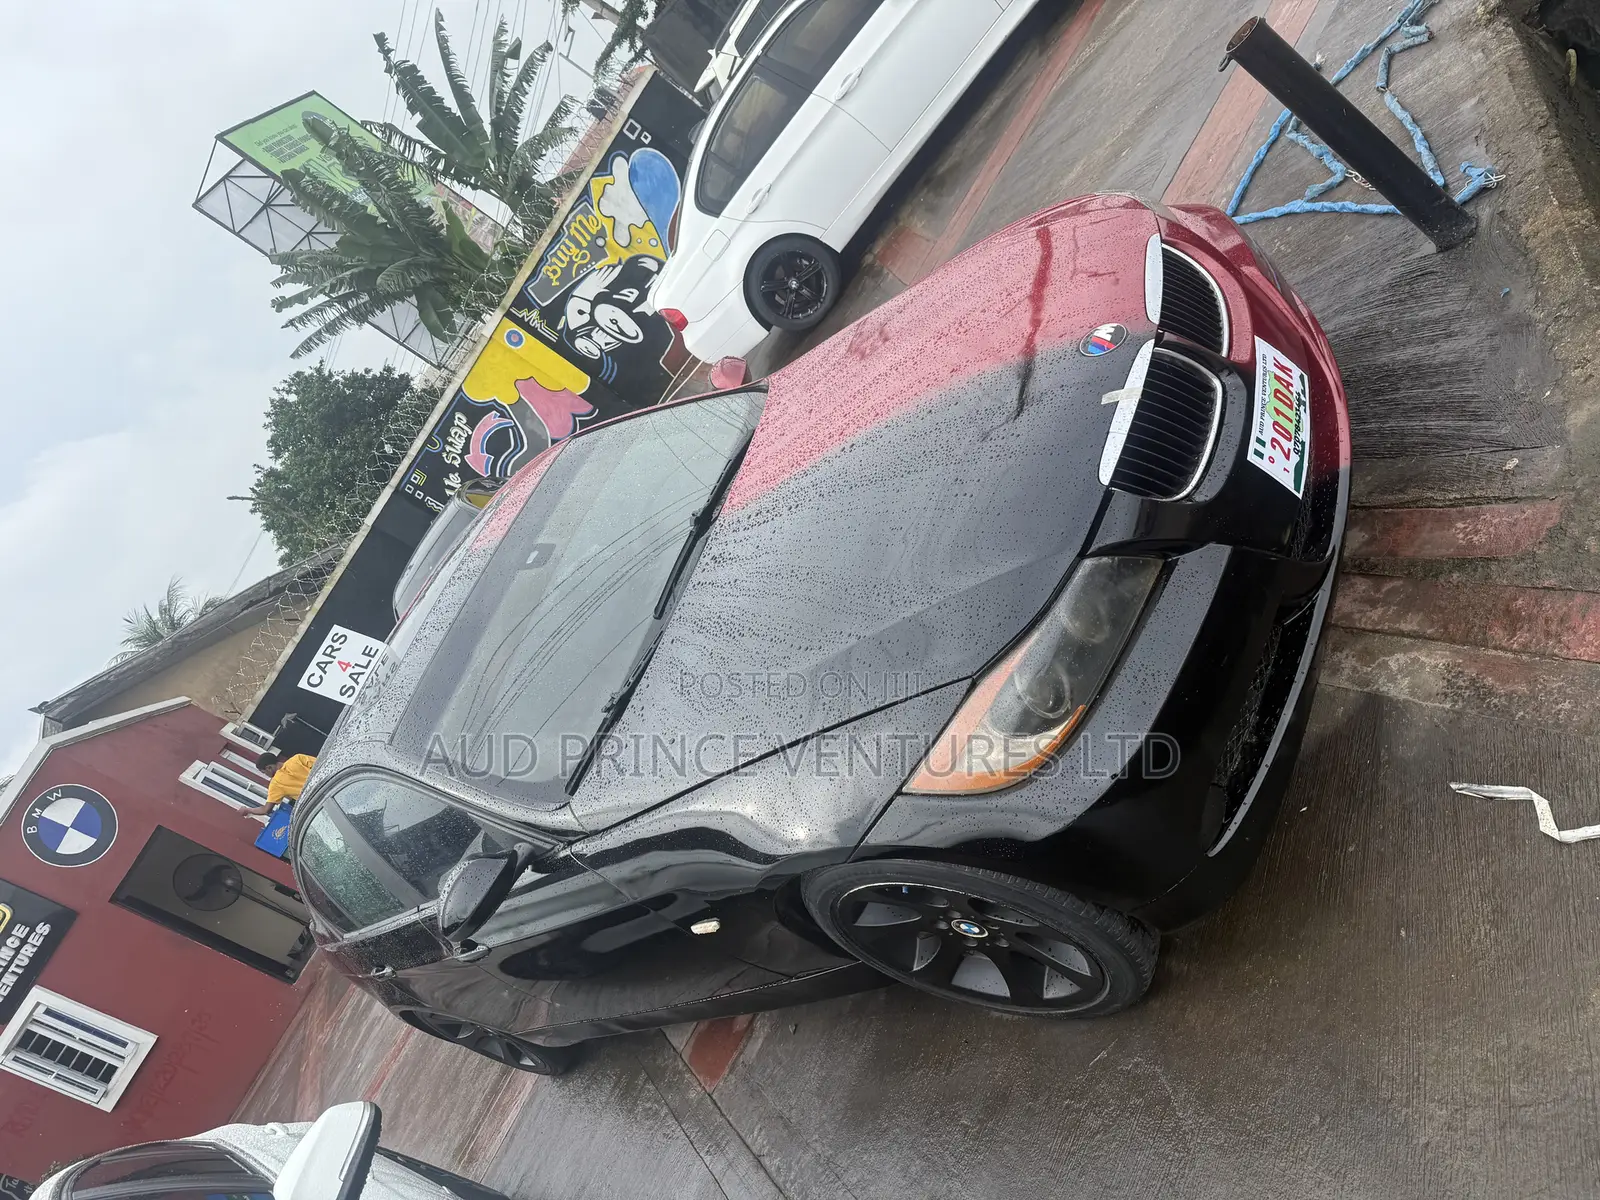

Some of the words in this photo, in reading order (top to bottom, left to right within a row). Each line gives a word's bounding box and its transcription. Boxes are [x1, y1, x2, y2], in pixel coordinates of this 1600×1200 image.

[543, 239, 591, 286] Buy
[569, 214, 602, 247] Me
[306, 632, 348, 688] CARS
[337, 660, 352, 673] 4
[339, 645, 379, 698] SALE
[0, 923, 30, 973] INCE
[0, 921, 52, 1003] ENTURES
